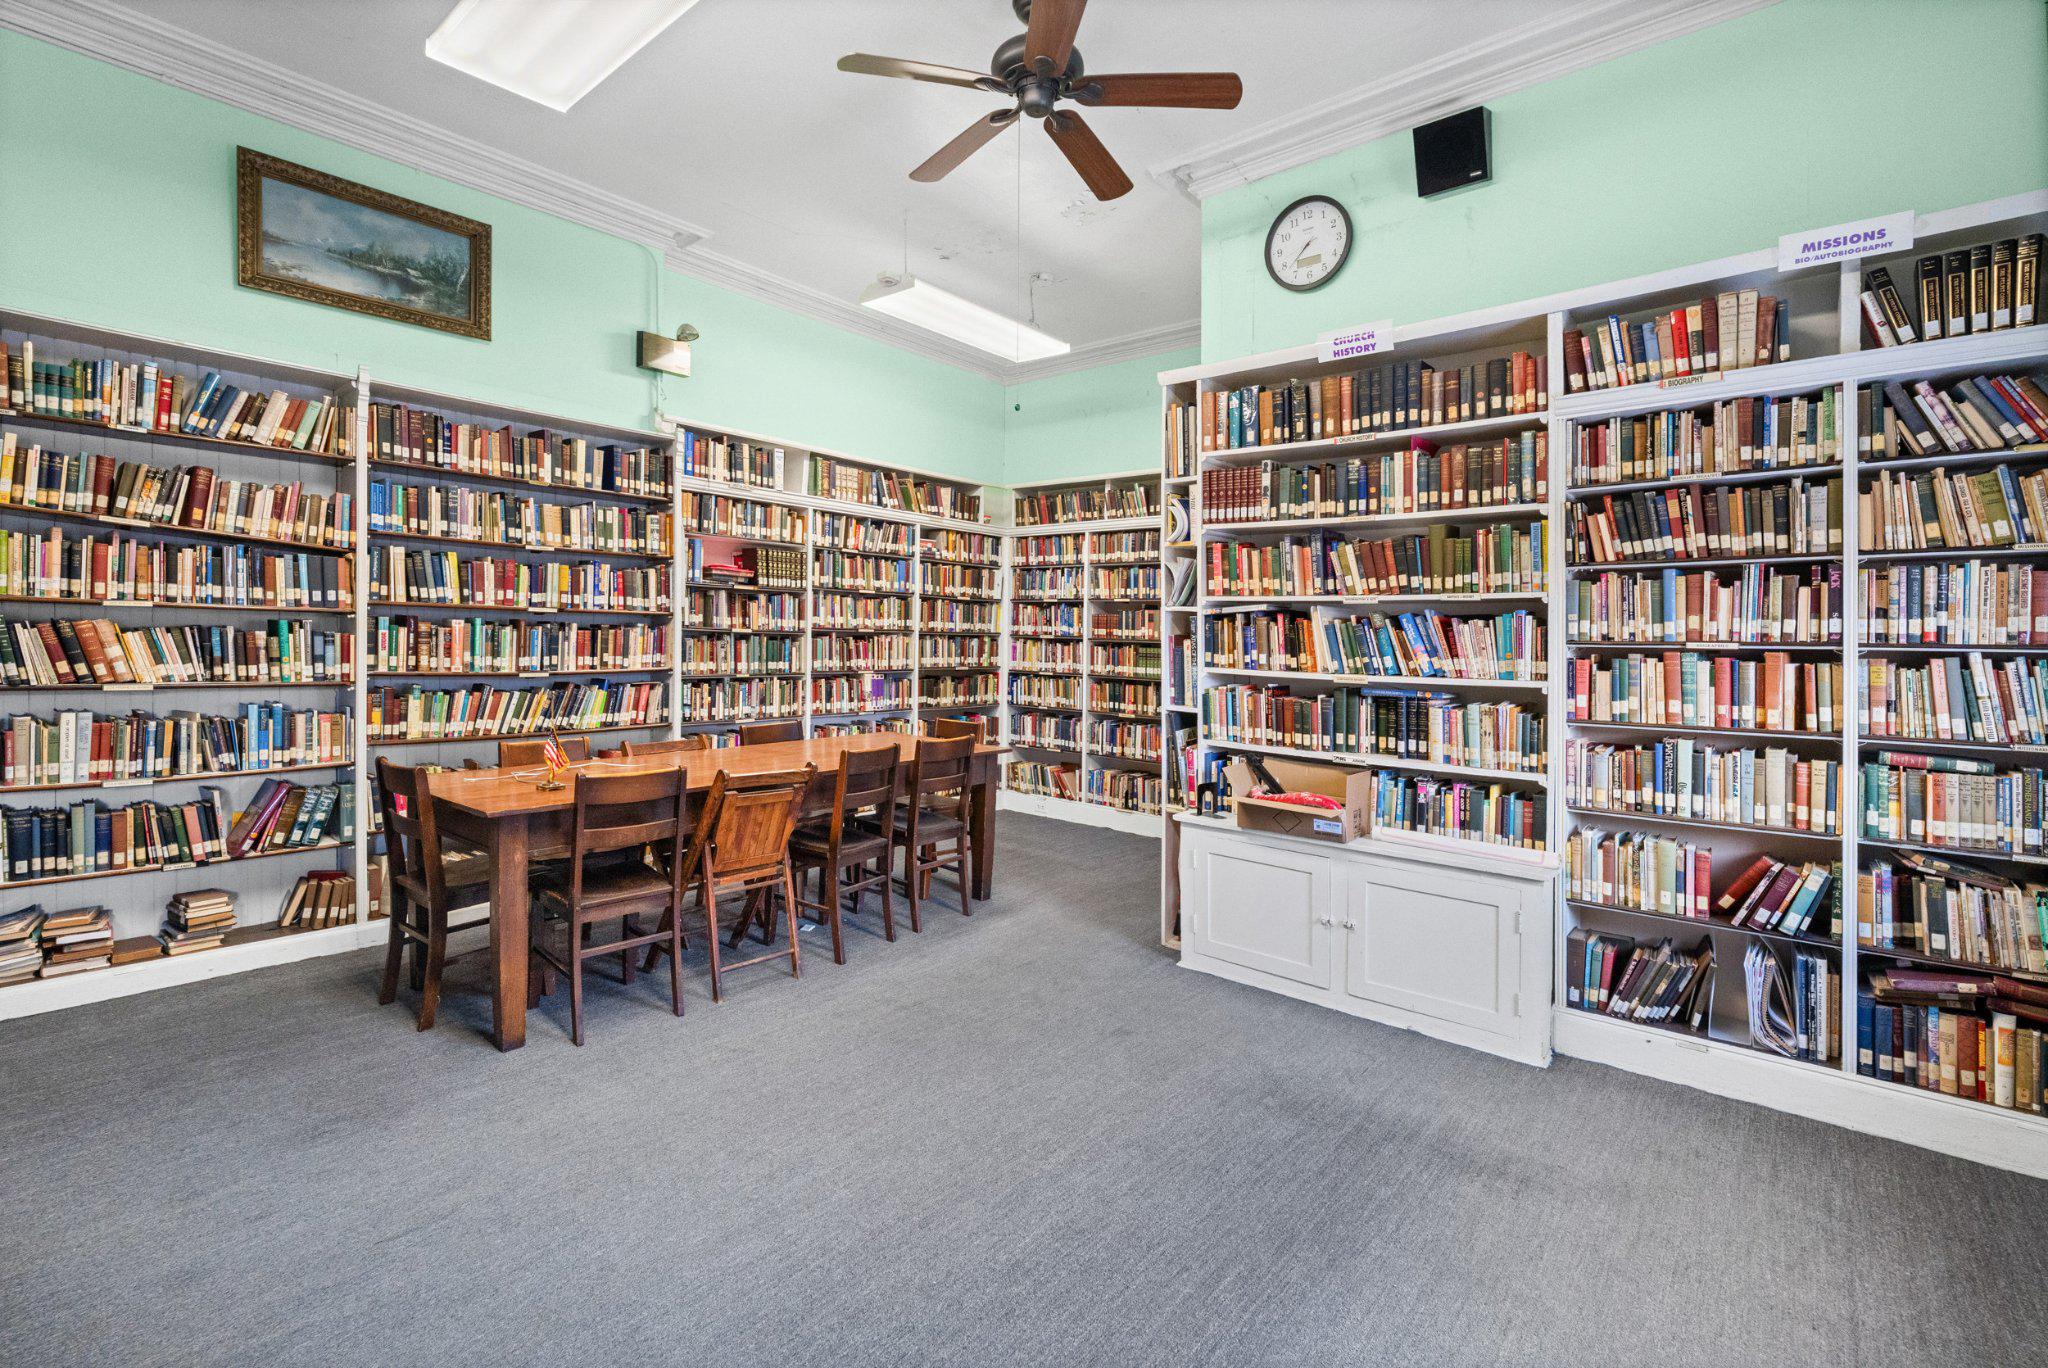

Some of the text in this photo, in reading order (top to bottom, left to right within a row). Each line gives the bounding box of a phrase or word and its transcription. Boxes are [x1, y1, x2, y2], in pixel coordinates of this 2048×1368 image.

[1303, 209, 1313, 220] 12
[1321, 210, 1325, 219] 1
[1290, 218, 1299, 229] 11
[1330, 219, 1336, 229] 2
[1281, 233, 1290, 243] 10
[1336, 232, 1342, 241] 3
[1801, 228, 1887, 254] MISSIONS
[1276, 249, 1282, 257] 9
[1332, 248, 1337, 257] 4
[1794, 241, 1894, 264] BIO/AUTOBIOGRAPHY
[1281, 261, 1287, 271] 8
[1321, 263, 1327, 271] 5
[1293, 270, 1298, 279] 7
[1306, 270, 1312, 279] 6
[1333, 331, 1375, 346] CHURCH
[1333, 342, 1377, 358] HISTORY
[1667, 375, 1704, 388] BIOGRAPHY
[1665, 740, 1674, 769] DAKTAR
[2024, 773, 2032, 802] ANOTHER
[2024, 802, 2032, 821] HAND
